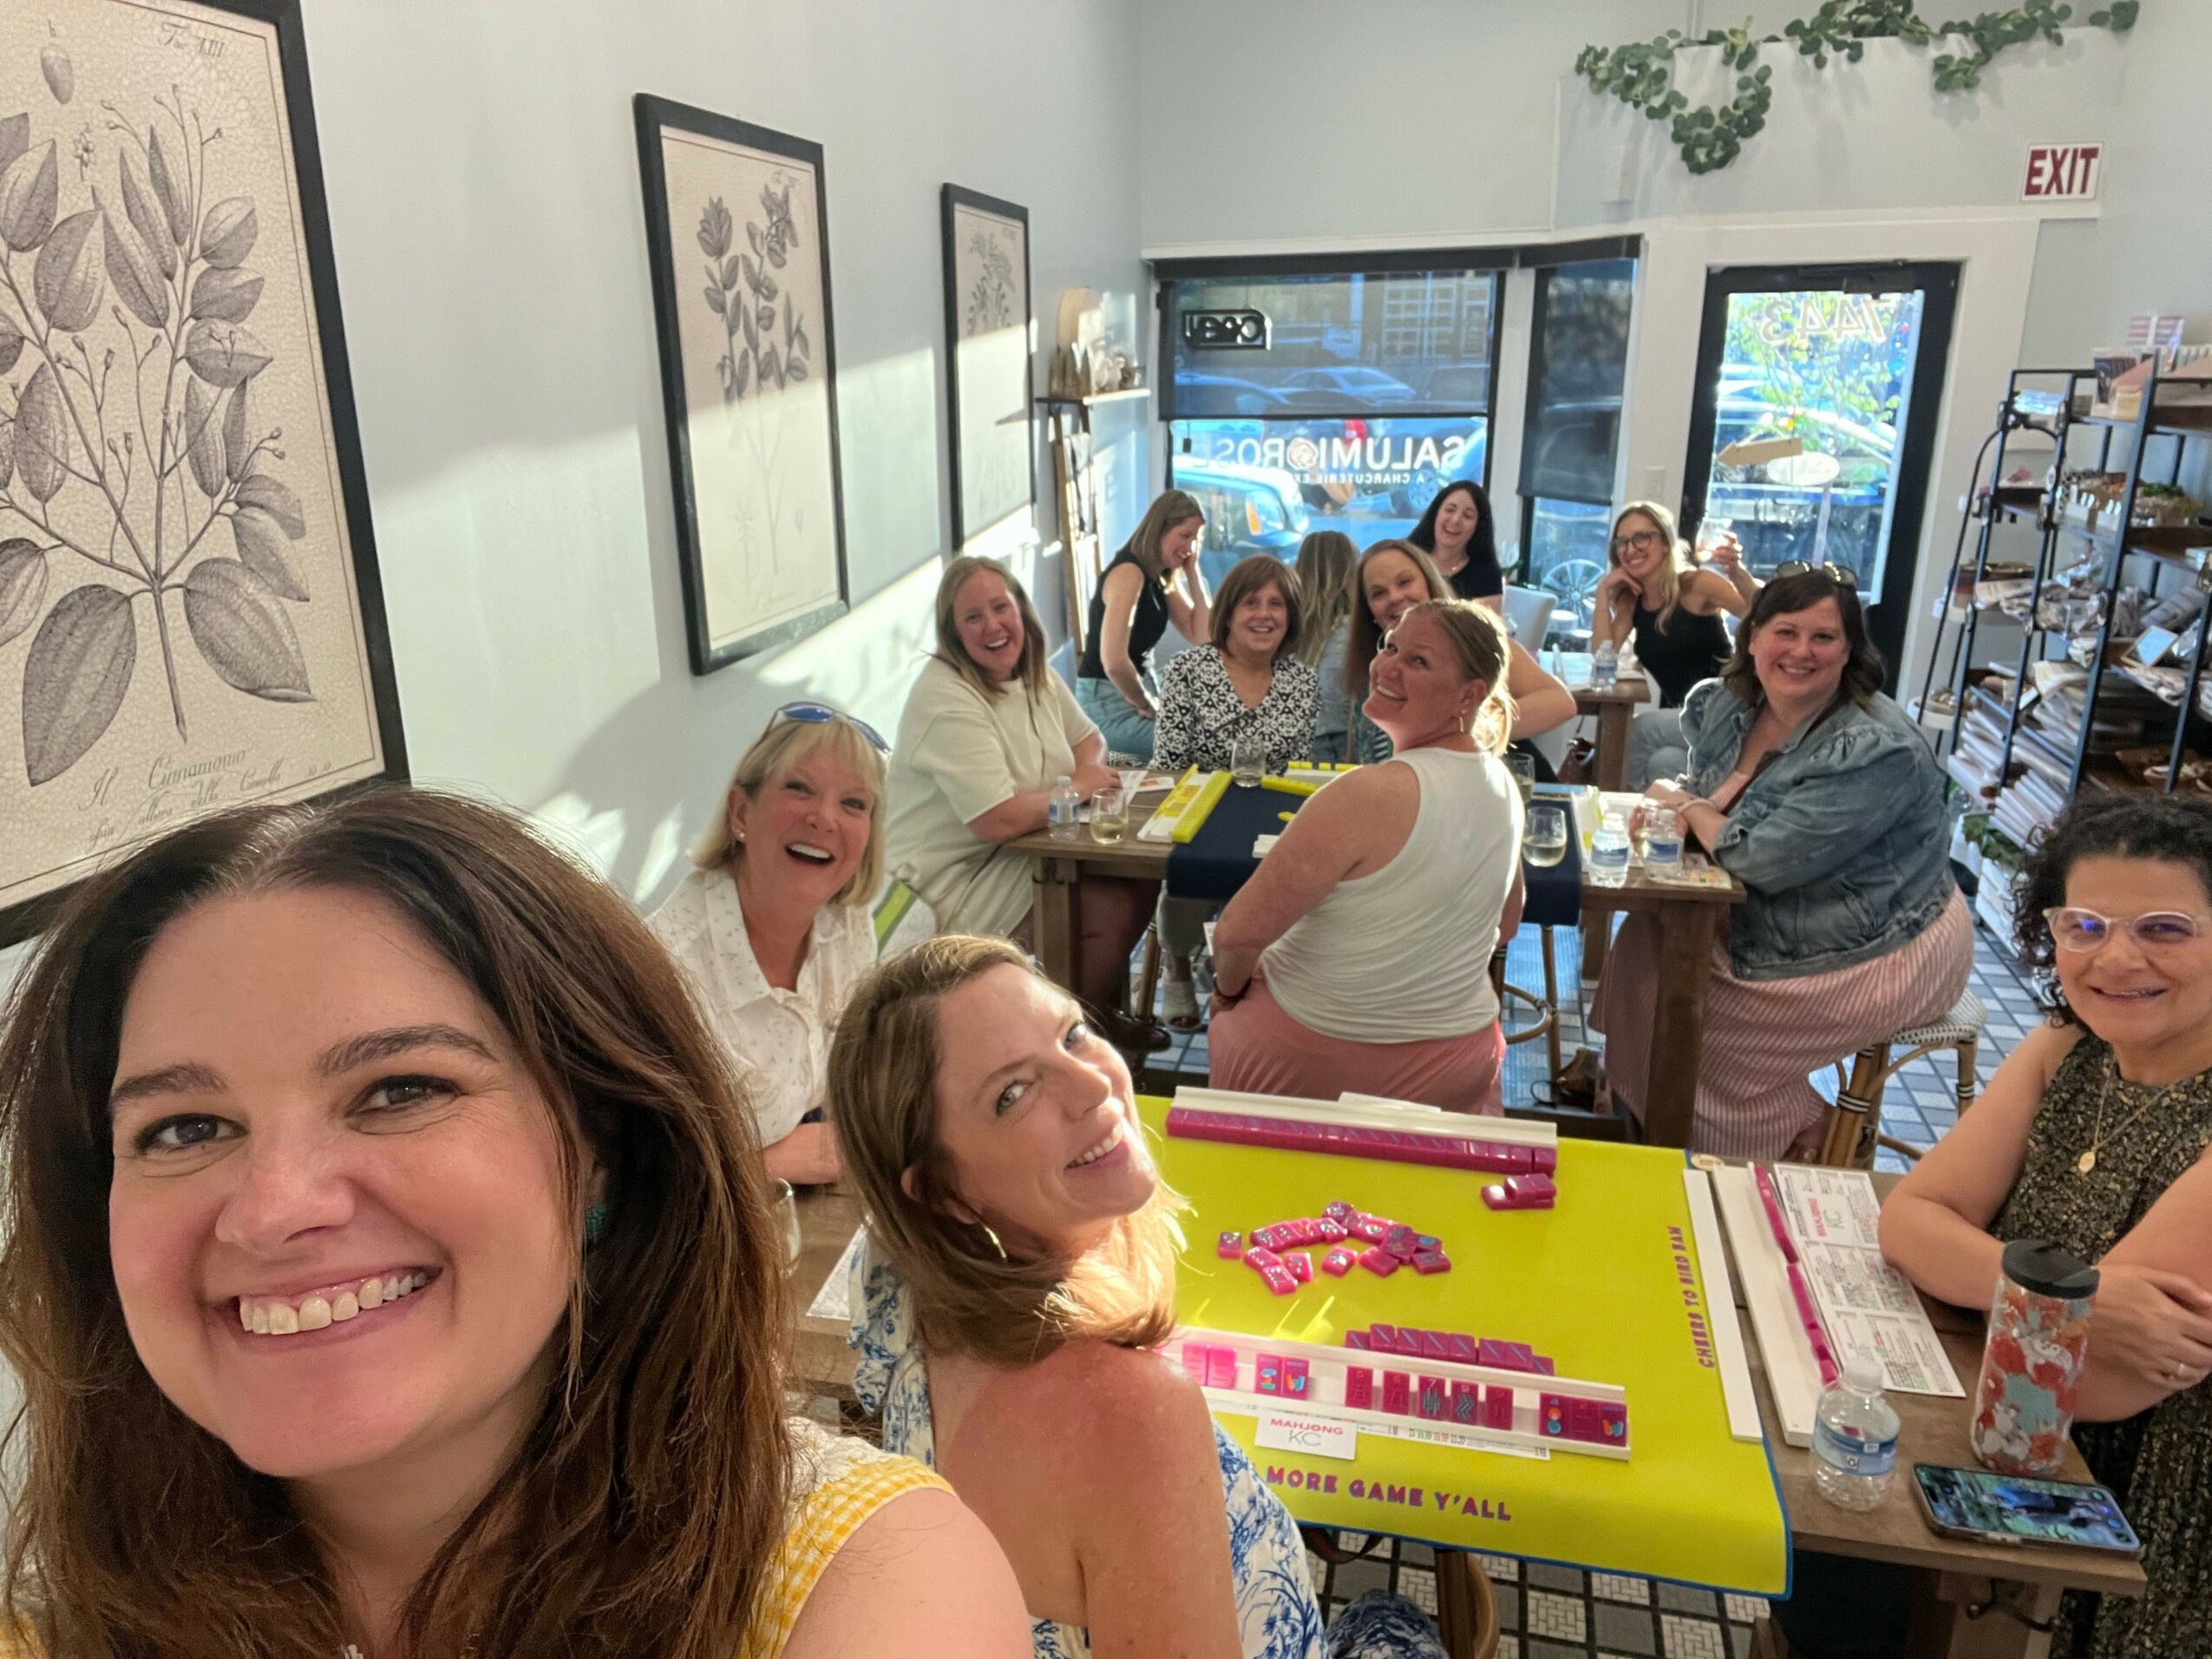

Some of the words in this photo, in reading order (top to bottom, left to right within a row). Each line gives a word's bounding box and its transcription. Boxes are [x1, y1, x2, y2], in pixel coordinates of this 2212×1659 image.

[2025, 147, 2099, 196] EXIT
[1681, 1289, 1700, 1307] TO
[1687, 1312, 1716, 1368] CHEERS
[1269, 1418, 1345, 1435] MAHJONG
[1288, 1429, 1322, 1447] KC
[1266, 1465, 1338, 1494] MORE
[1349, 1479, 1424, 1507] GAME
[1433, 1491, 1512, 1522] Y'ALL
